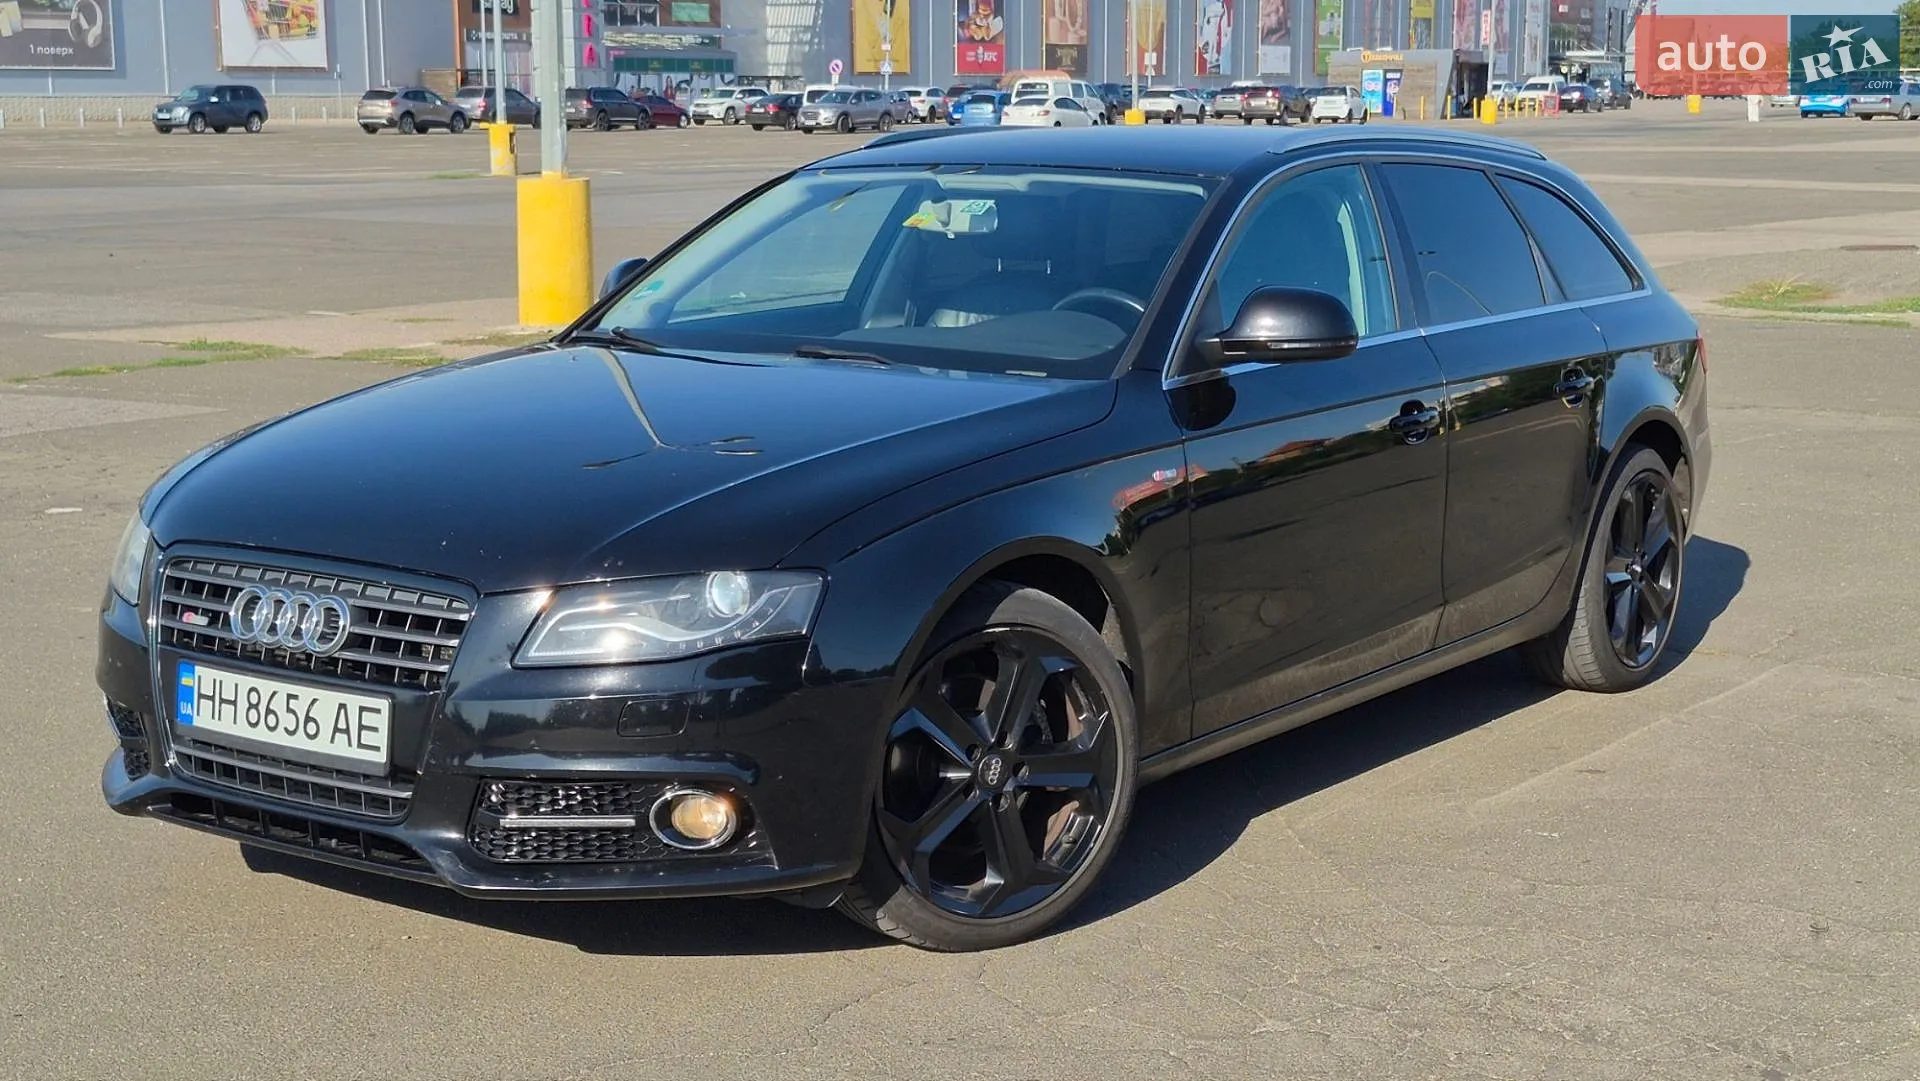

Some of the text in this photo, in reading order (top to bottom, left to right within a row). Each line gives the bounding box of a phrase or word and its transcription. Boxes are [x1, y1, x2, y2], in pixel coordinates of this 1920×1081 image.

[29, 44, 74, 56] 1 поверх
[180, 701, 193, 717] UA
[245, 686, 320, 741] 8656
[329, 702, 382, 753] AE
